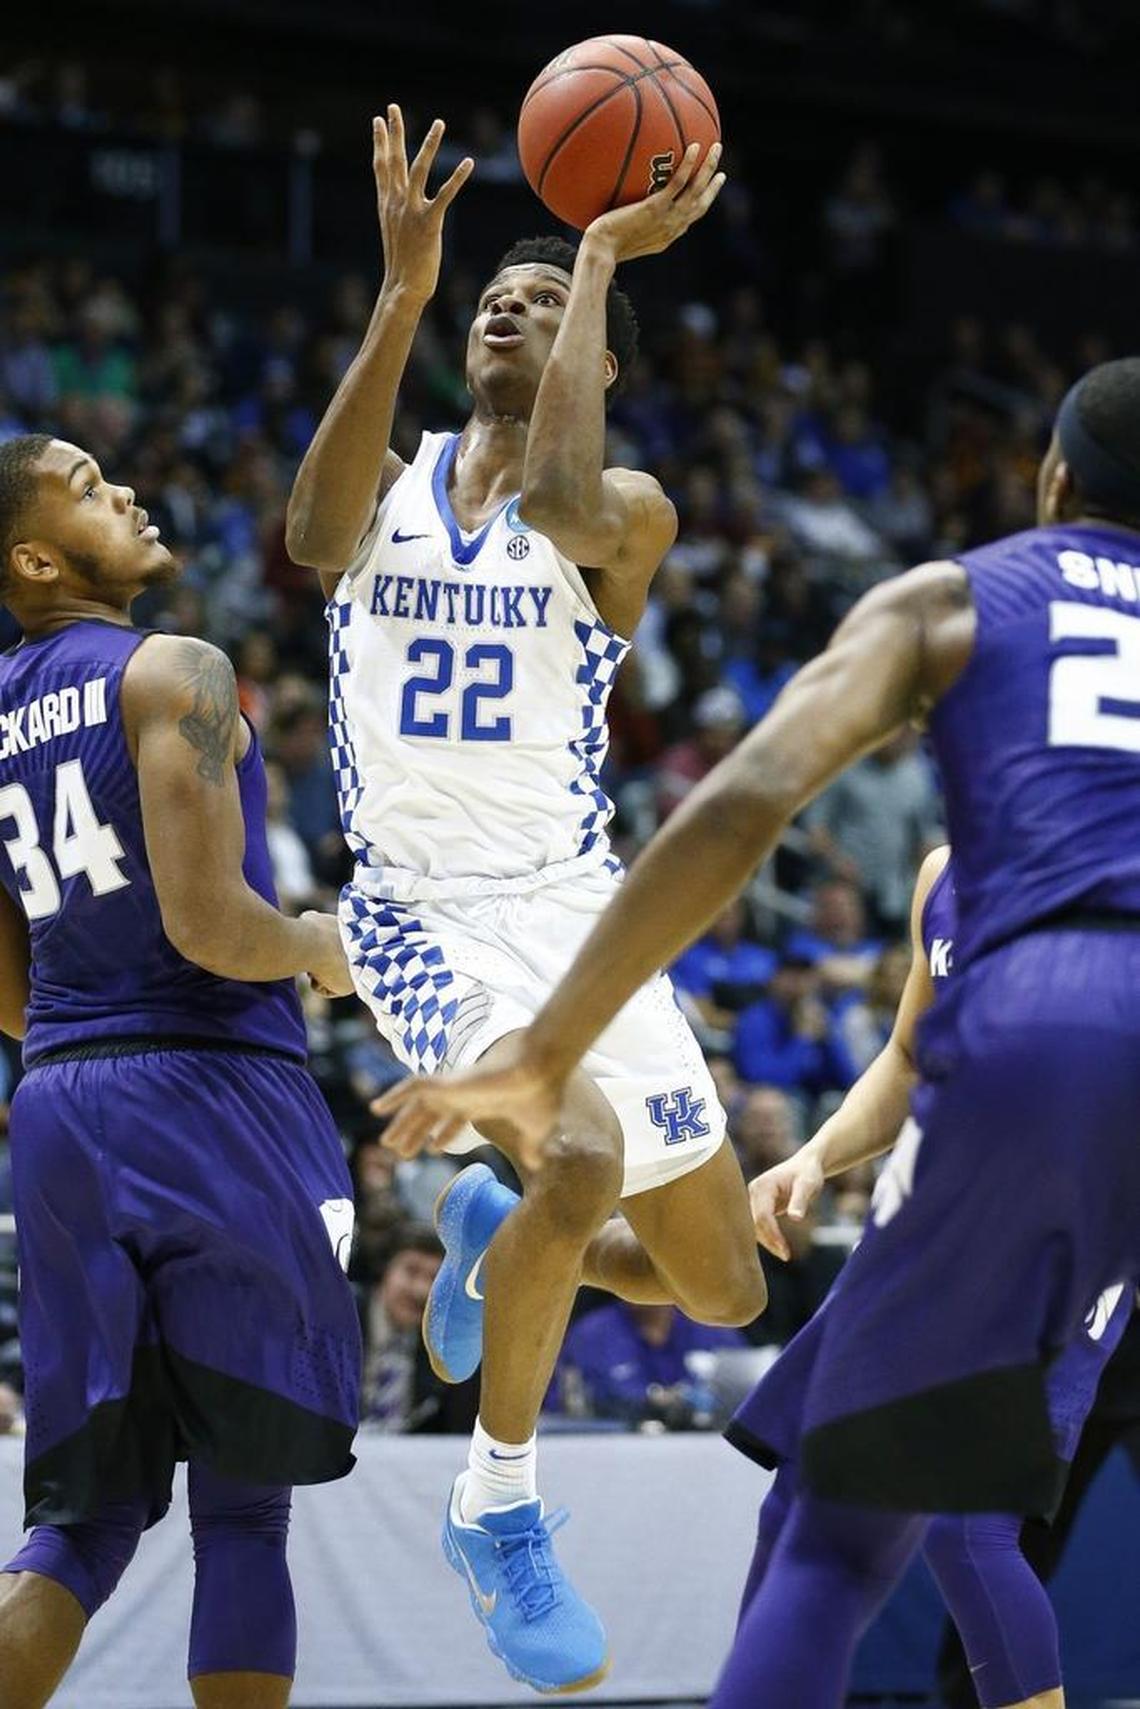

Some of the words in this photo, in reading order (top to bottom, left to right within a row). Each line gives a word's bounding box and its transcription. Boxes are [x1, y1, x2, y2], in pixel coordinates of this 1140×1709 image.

[507, 538, 529, 559] SEC
[370, 574, 552, 628] KENTUCKY
[1057, 550, 1140, 602] SN
[84, 677, 107, 727] III
[399, 637, 516, 742] 22
[0, 758, 132, 920] 34
[645, 1086, 711, 1146] UK
